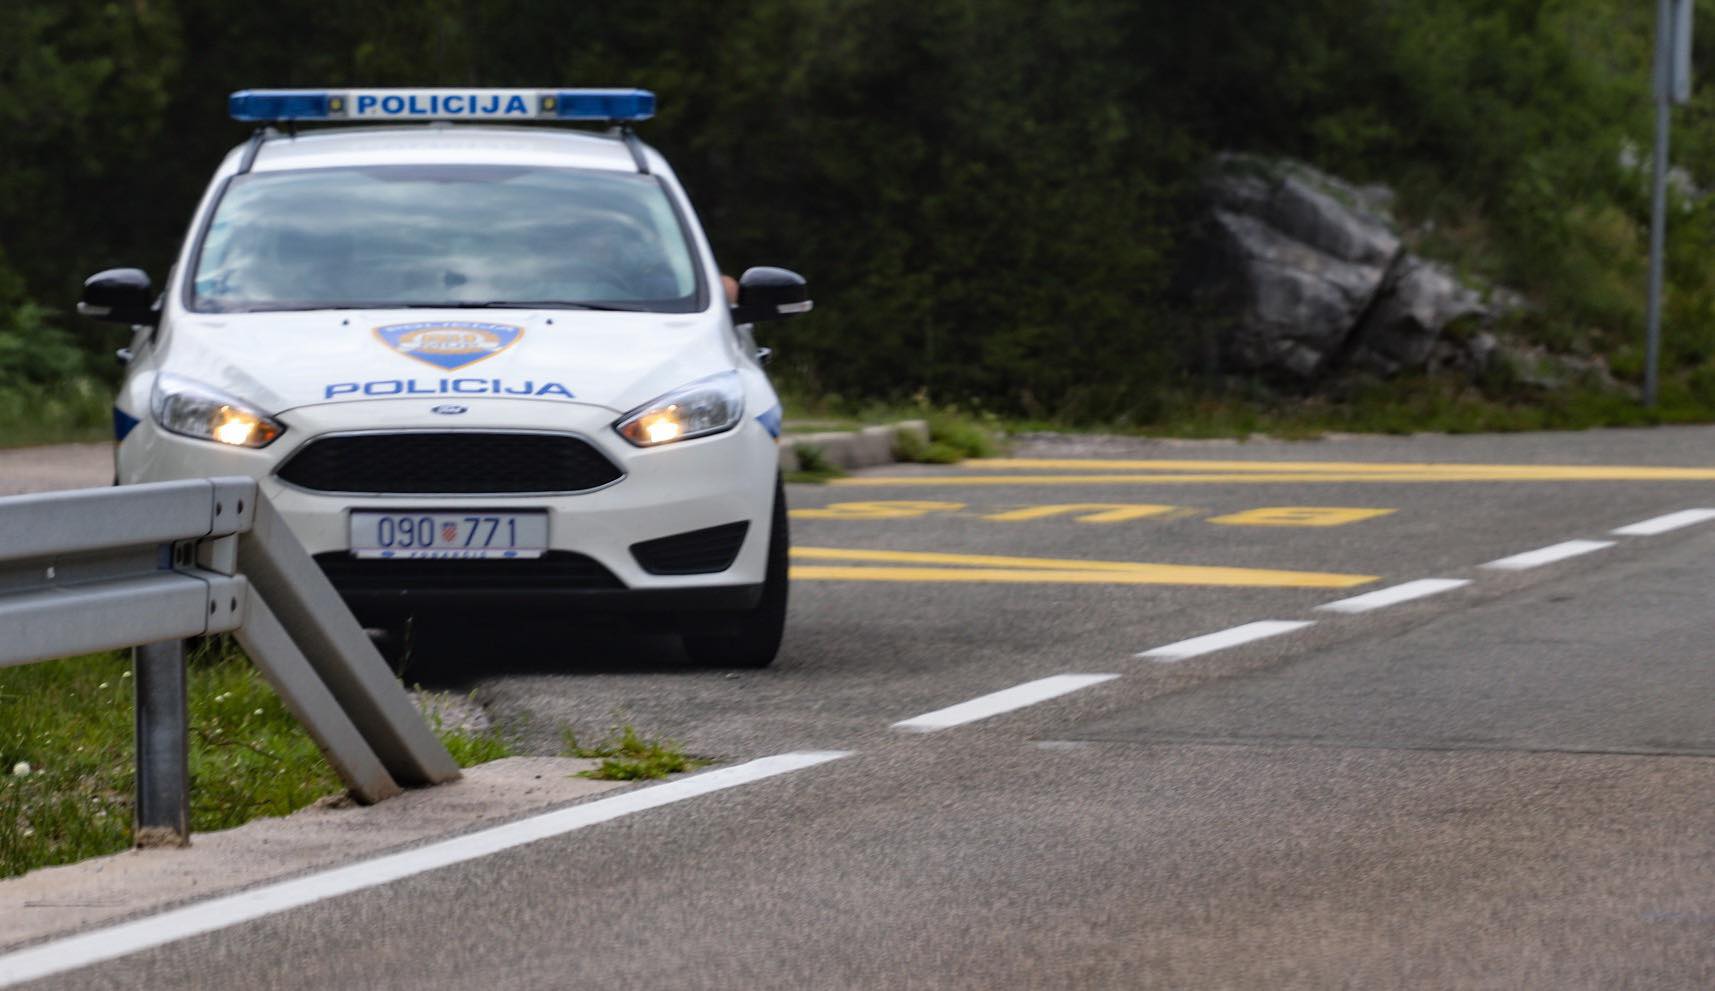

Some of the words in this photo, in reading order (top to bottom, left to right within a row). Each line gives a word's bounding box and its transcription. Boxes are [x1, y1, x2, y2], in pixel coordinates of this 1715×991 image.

[356, 95, 529, 115] POLICIJA
[323, 378, 577, 399] POLICIJA
[377, 516, 435, 548] 090
[463, 517, 517, 548] 771
